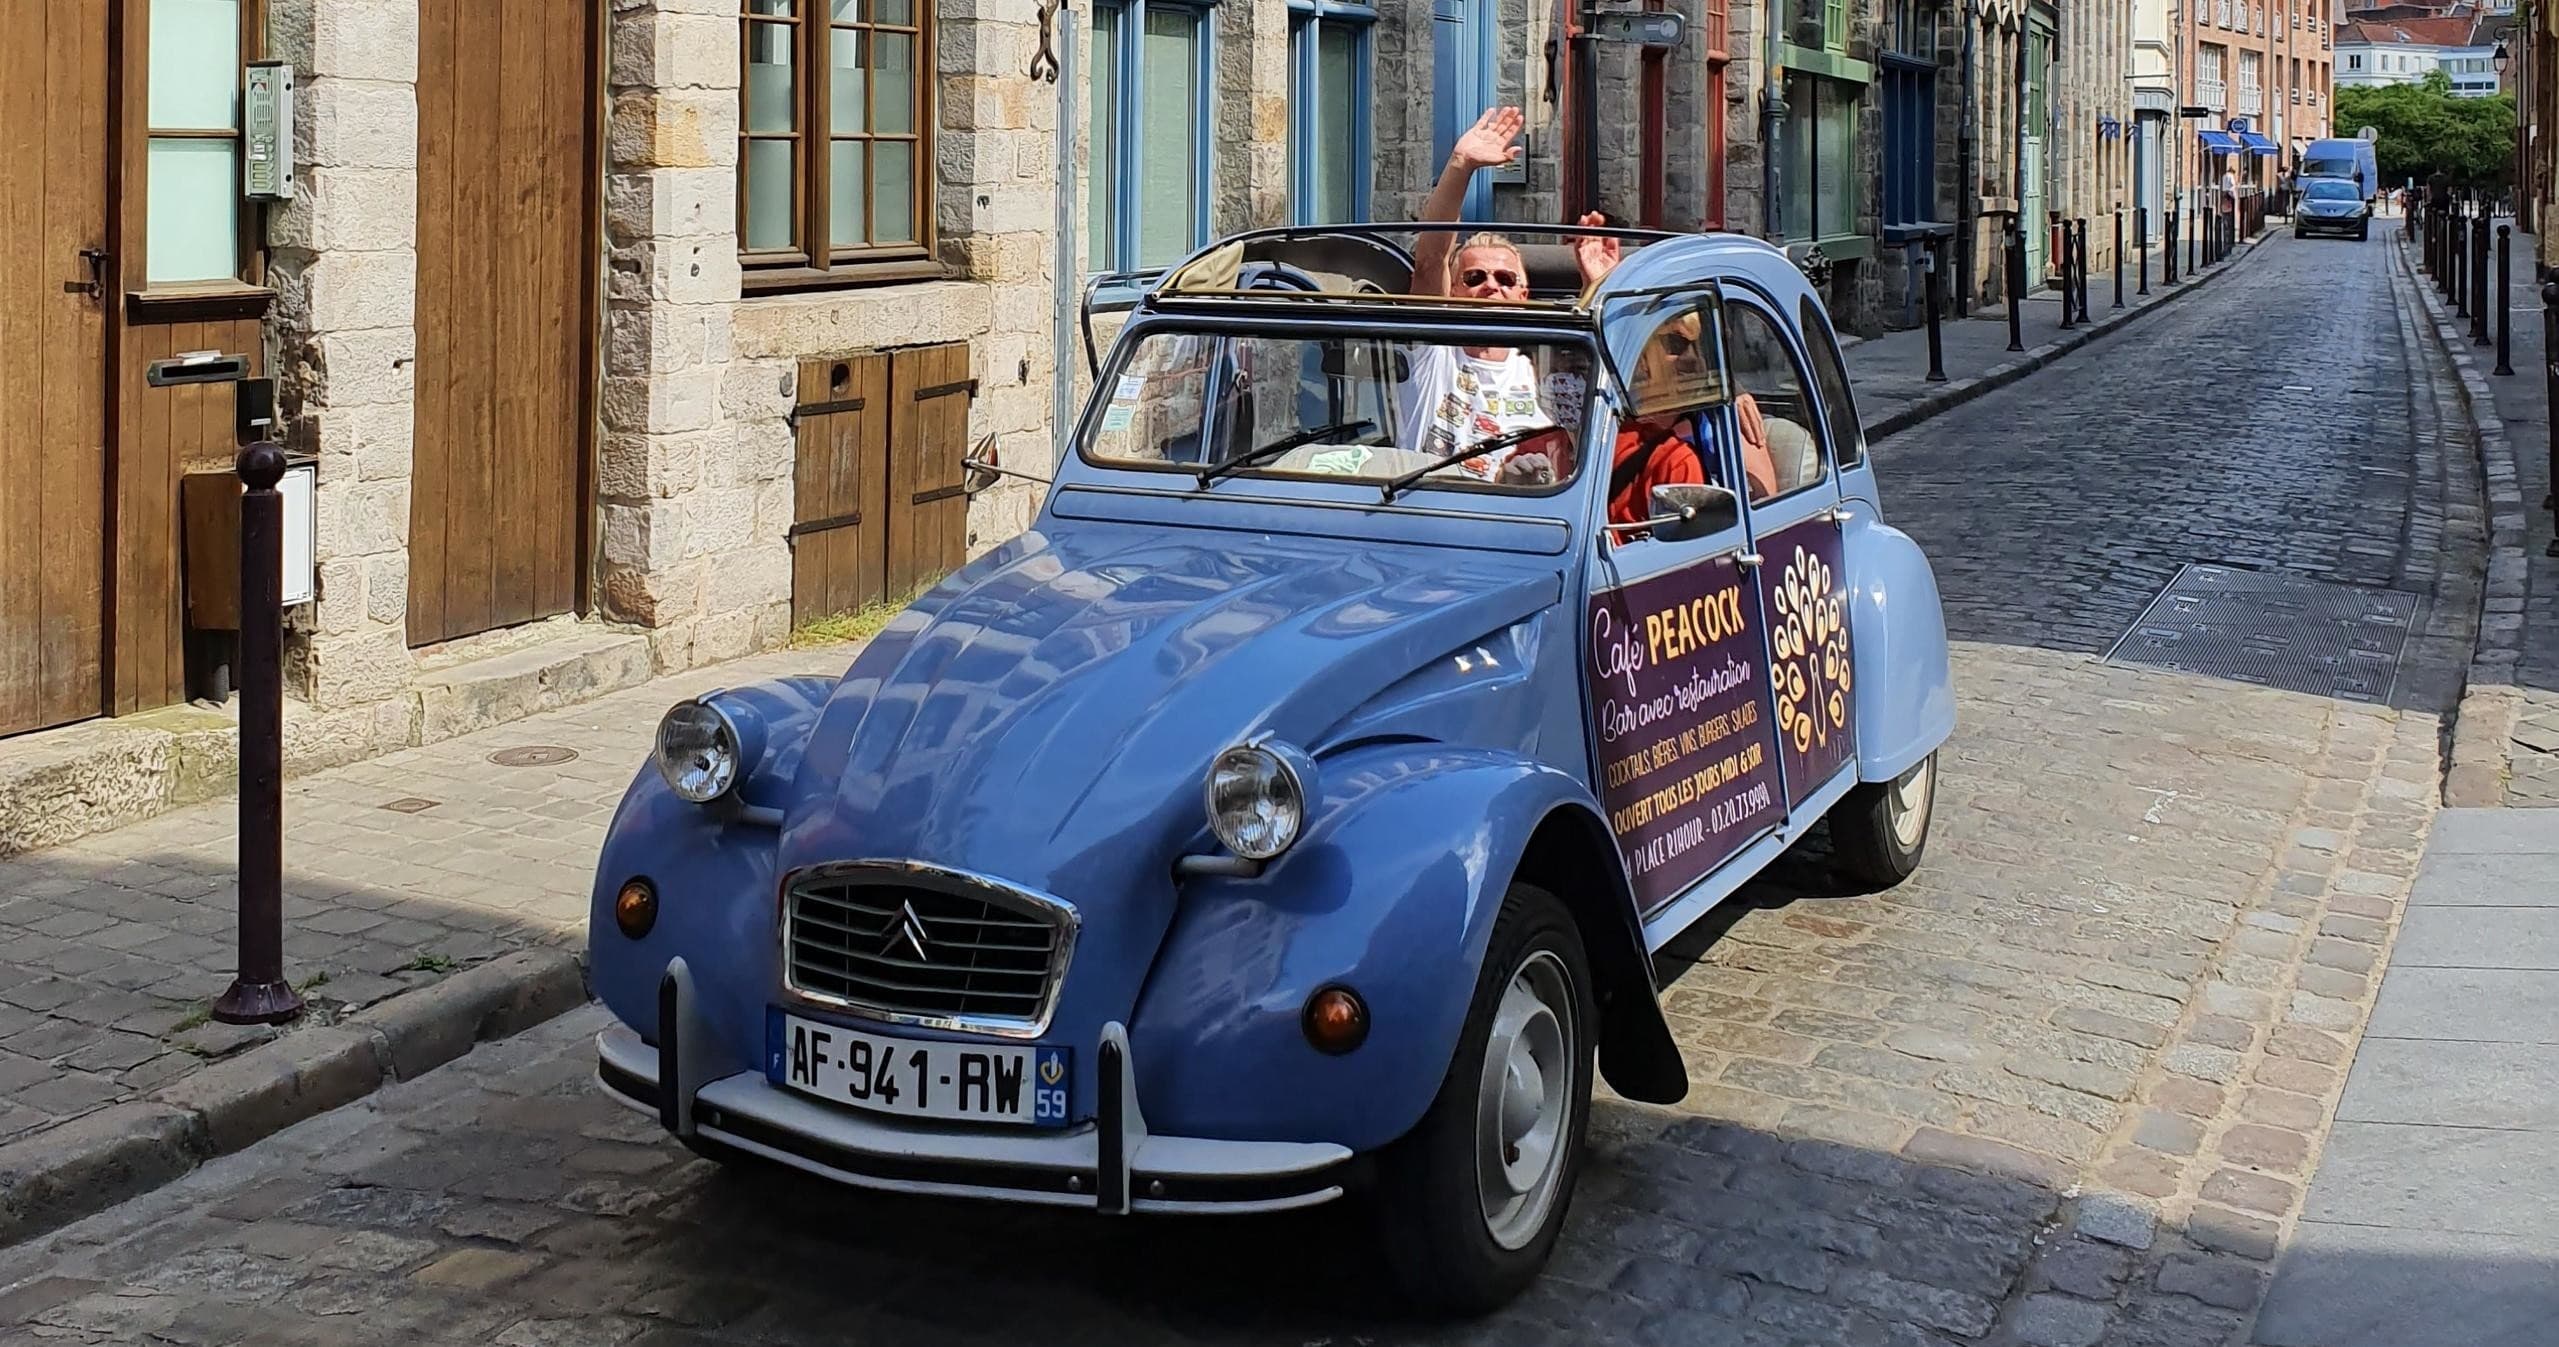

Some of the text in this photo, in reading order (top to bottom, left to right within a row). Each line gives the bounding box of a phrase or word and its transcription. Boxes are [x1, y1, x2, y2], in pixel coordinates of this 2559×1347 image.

[1594, 584, 1745, 697] Café PEACOCK
[1602, 652, 1751, 742] Bar avec restauration
[1614, 742, 1764, 835] OUVERT TOUS LES JOURS MIDI & SOIR
[1634, 837, 1666, 876] PLACE
[1666, 816, 1705, 859] RIHOUR
[772, 1052, 780, 1069] F
[1037, 1088, 1067, 1118] 59
